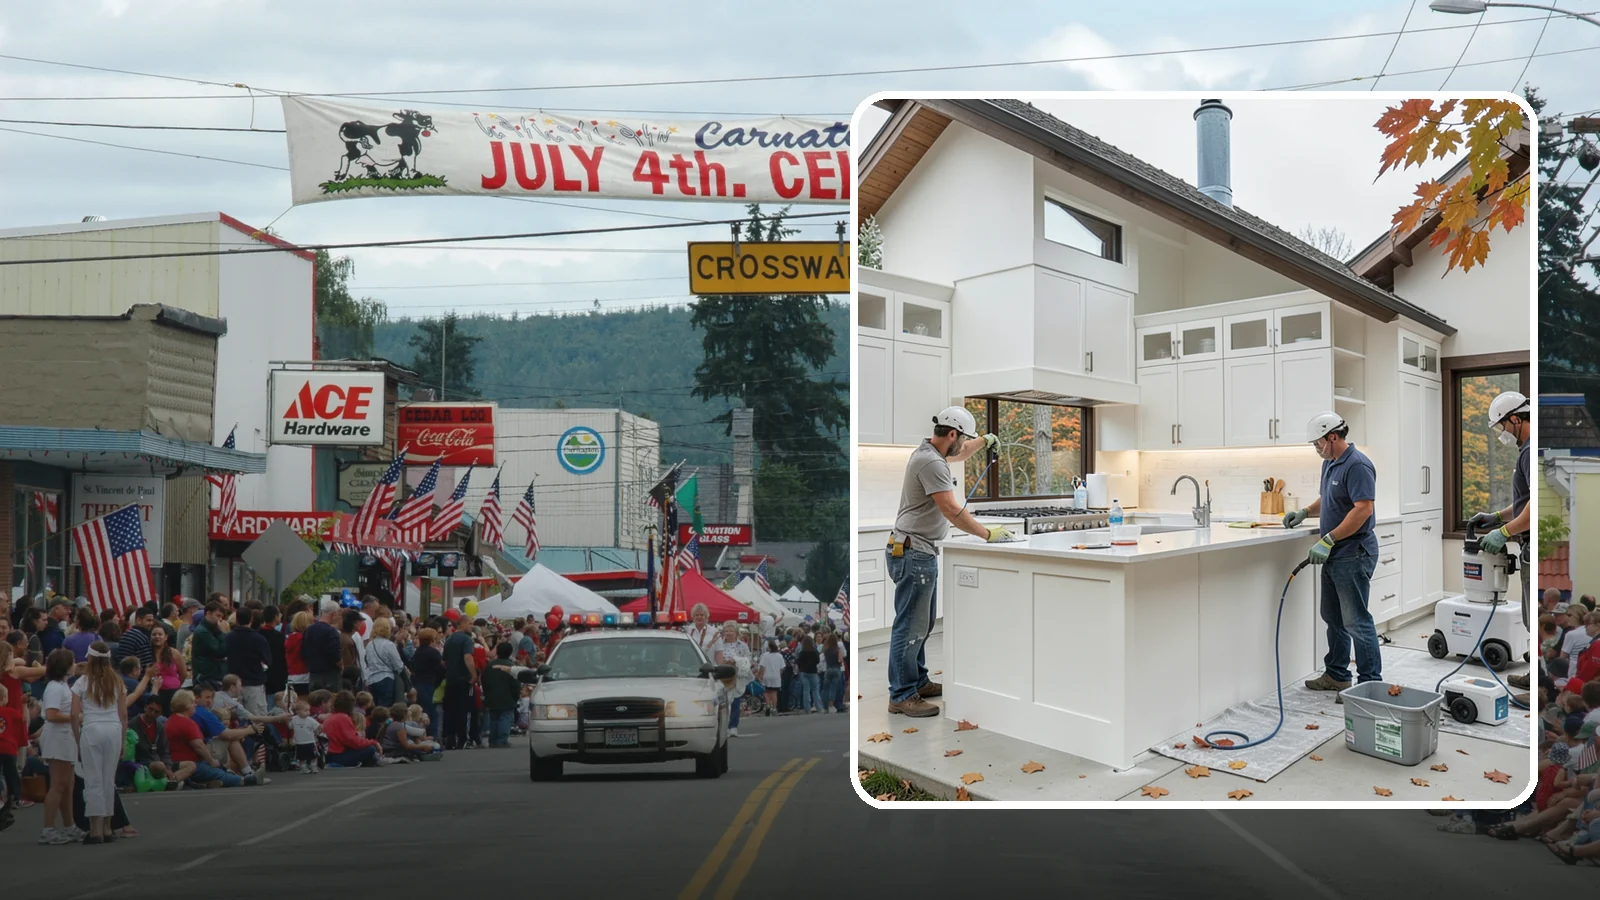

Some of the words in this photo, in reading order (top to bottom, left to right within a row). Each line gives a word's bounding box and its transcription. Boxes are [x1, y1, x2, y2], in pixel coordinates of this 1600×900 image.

[481, 141, 605, 192] JULY
[632, 150, 746, 198] 4th.
[697, 254, 850, 280] CROSSWA
[283, 380, 373, 419] ACE
[406, 409, 452, 423] CEDAR
[283, 421, 371, 436] Hardware
[416, 428, 477, 447] Coca-Cola
[354, 467, 385, 480] Simpl
[83, 486, 94, 494] St.
[96, 485, 123, 495] Vincent
[126, 486, 134, 495] de
[137, 486, 155, 495] Paul
[213, 516, 330, 535] HARDARE
[688, 527, 741, 535] CRNATION
[699, 535, 730, 543] GLASS
